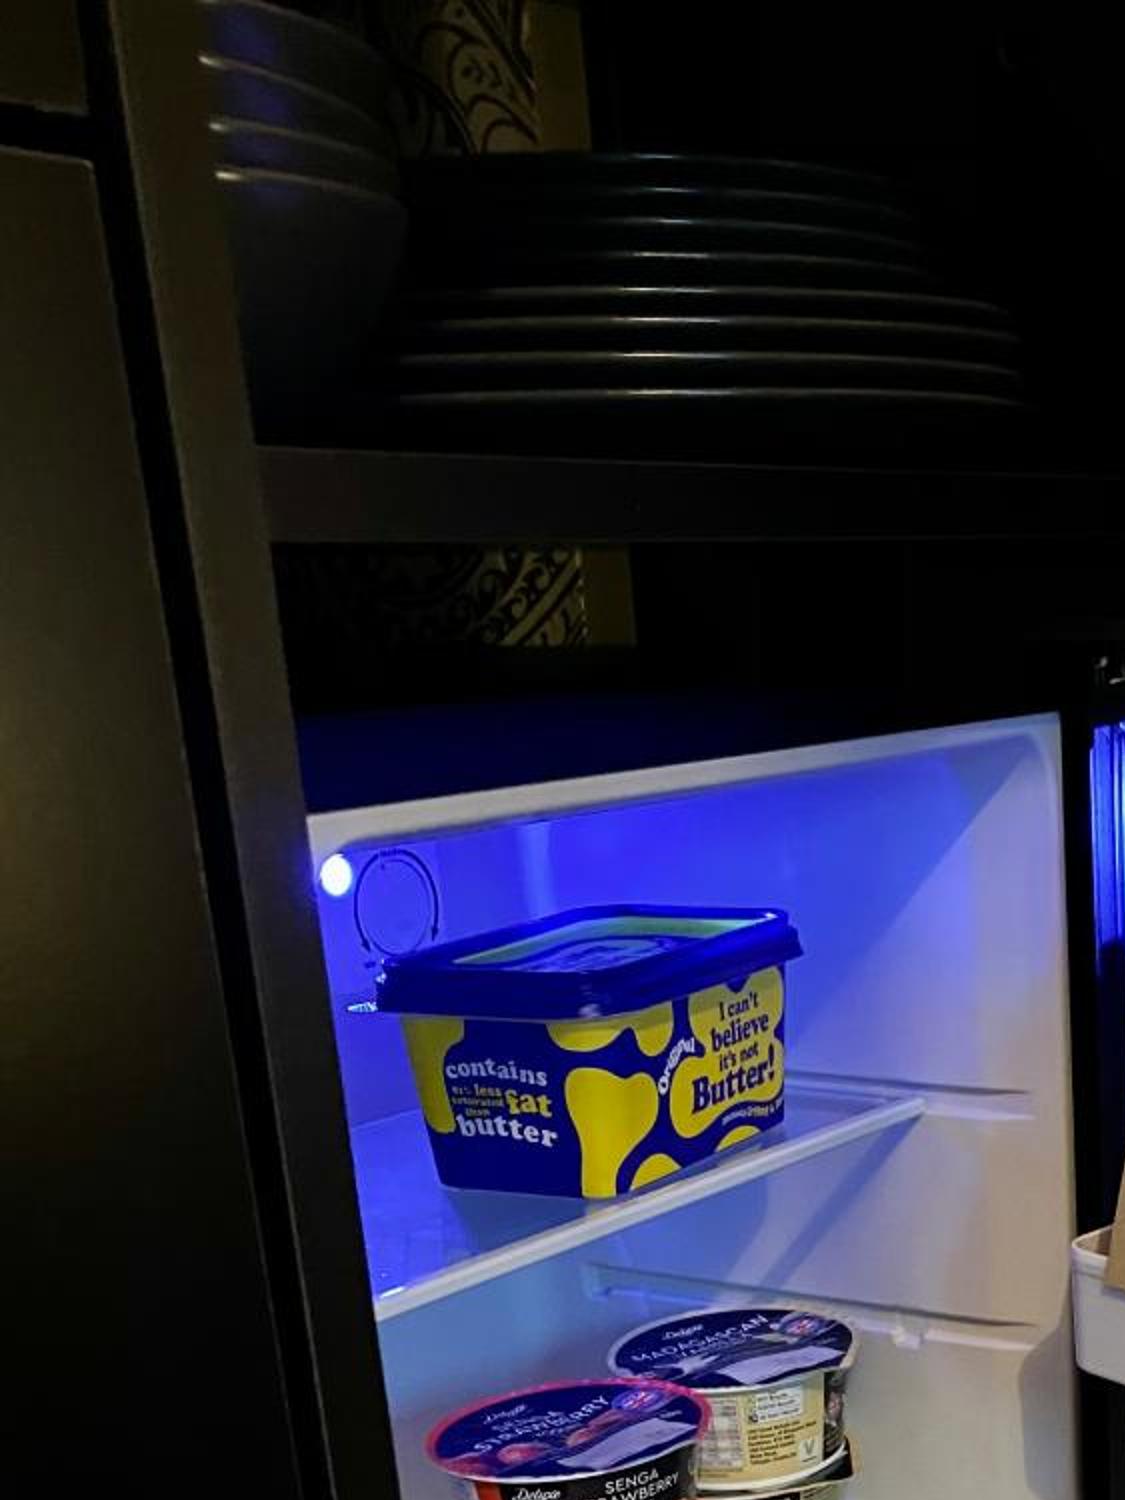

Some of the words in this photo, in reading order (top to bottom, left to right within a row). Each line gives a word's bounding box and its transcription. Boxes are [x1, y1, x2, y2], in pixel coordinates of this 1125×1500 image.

[728, 991, 758, 1017] can't
[711, 1013, 769, 1051] believe
[445, 1058, 548, 1087] contains
[719, 1051, 737, 1072] it's
[692, 1043, 775, 1114] Butter!
[504, 1089, 553, 1118] fat
[455, 1113, 559, 1148] butter
[604, 1466, 660, 1495] SENGA
